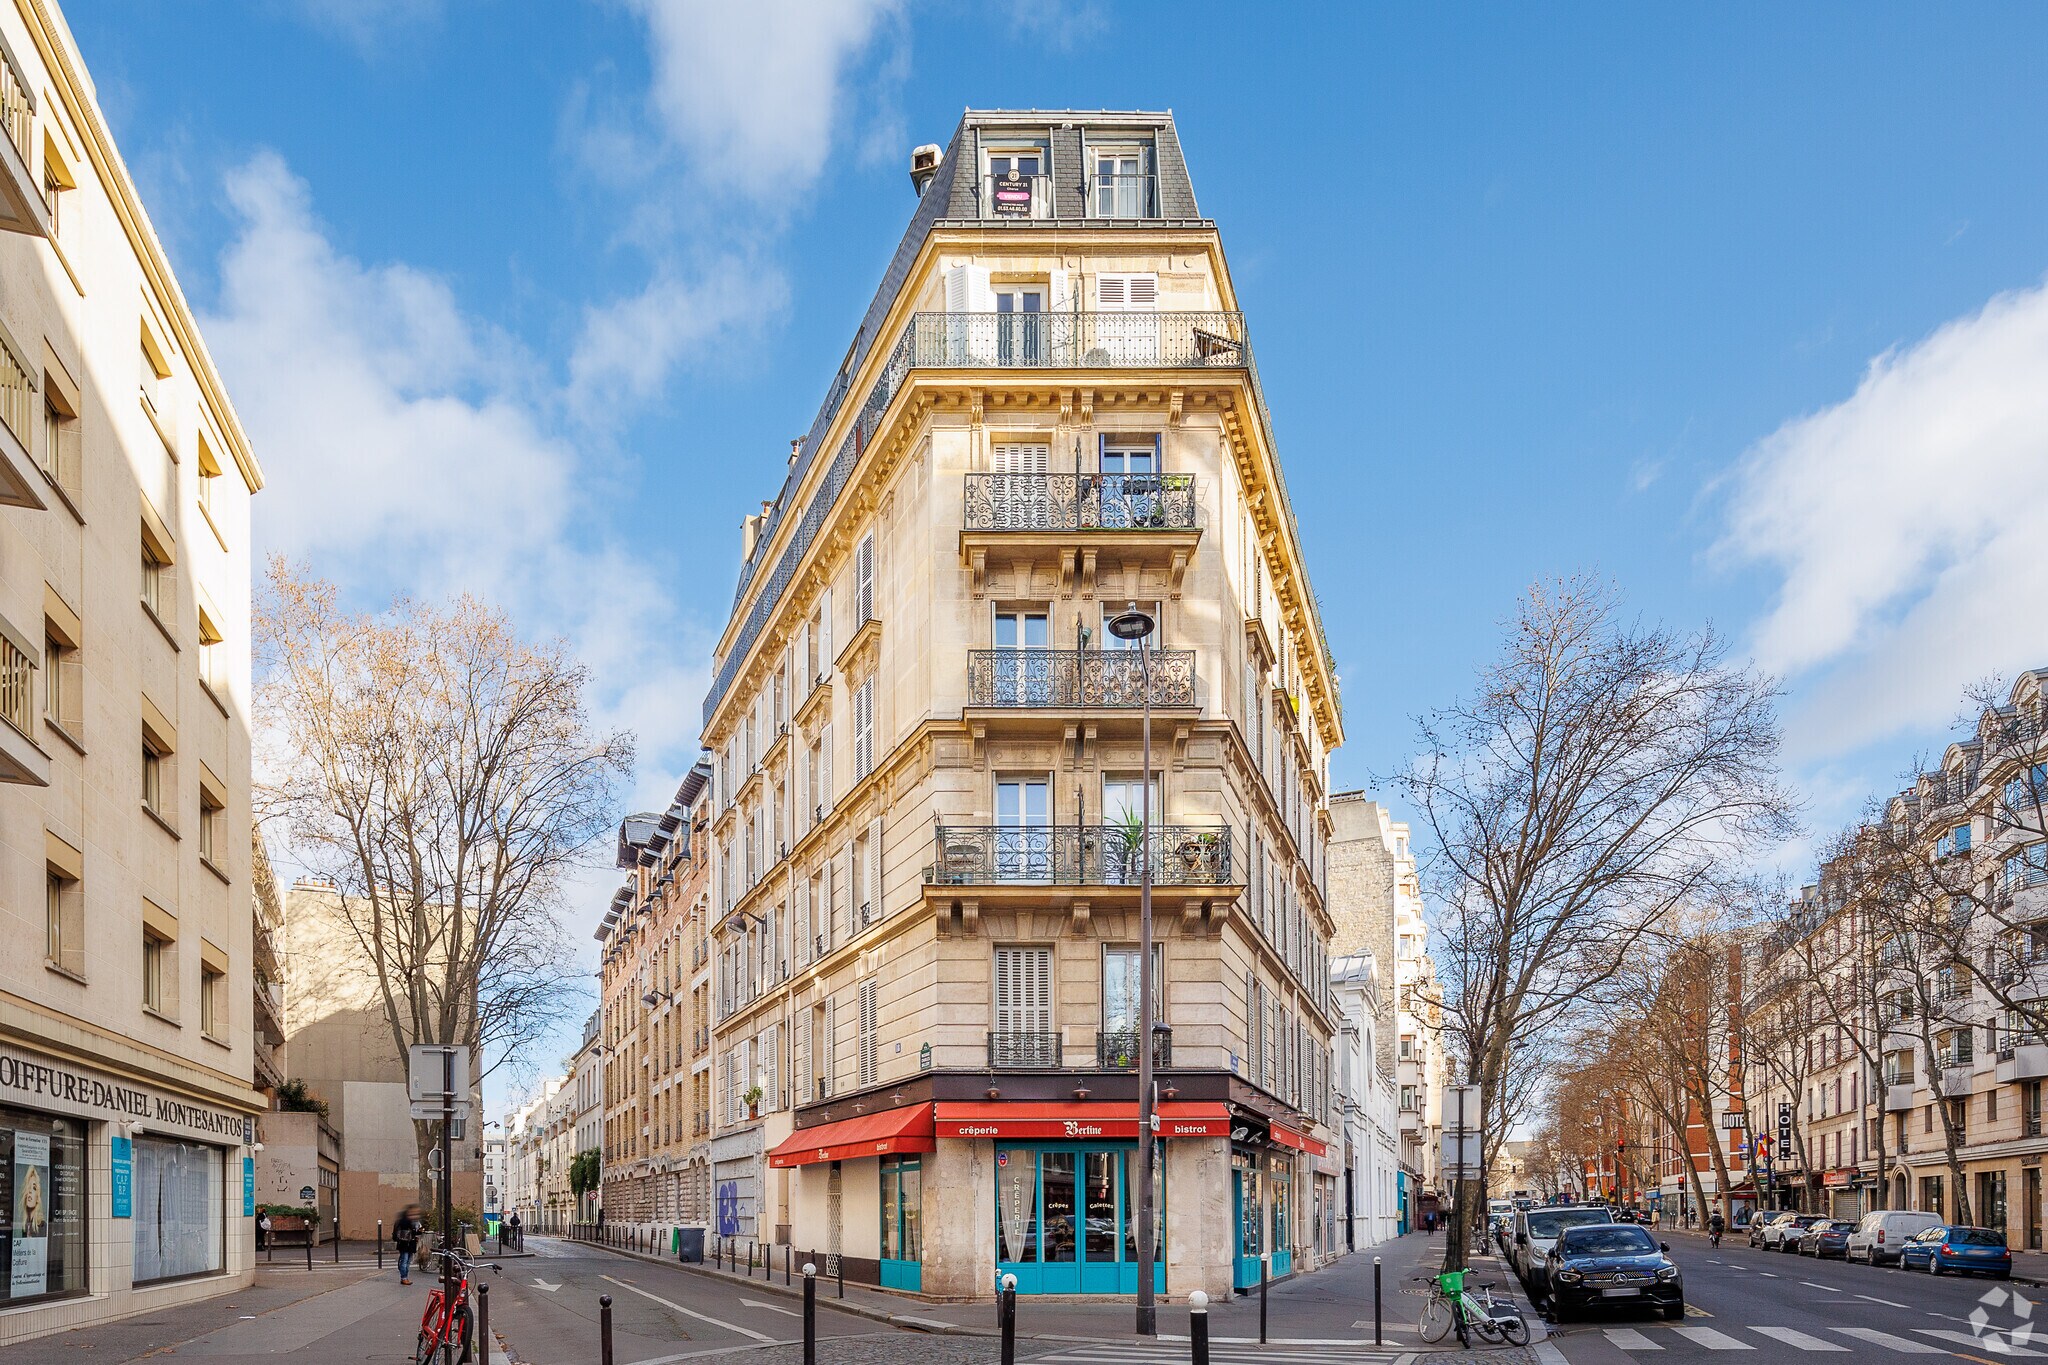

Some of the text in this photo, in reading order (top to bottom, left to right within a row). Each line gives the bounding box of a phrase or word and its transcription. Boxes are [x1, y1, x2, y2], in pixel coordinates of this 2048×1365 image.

[155, 1097, 242, 1137] MONTESANTOS
[1723, 1114, 1744, 1128] HOTE
[959, 1121, 1207, 1137] crêperie Bertine bistrot
[1779, 1104, 1790, 1160] HOTEL
[1466, 1299, 1483, 1316] Lime
